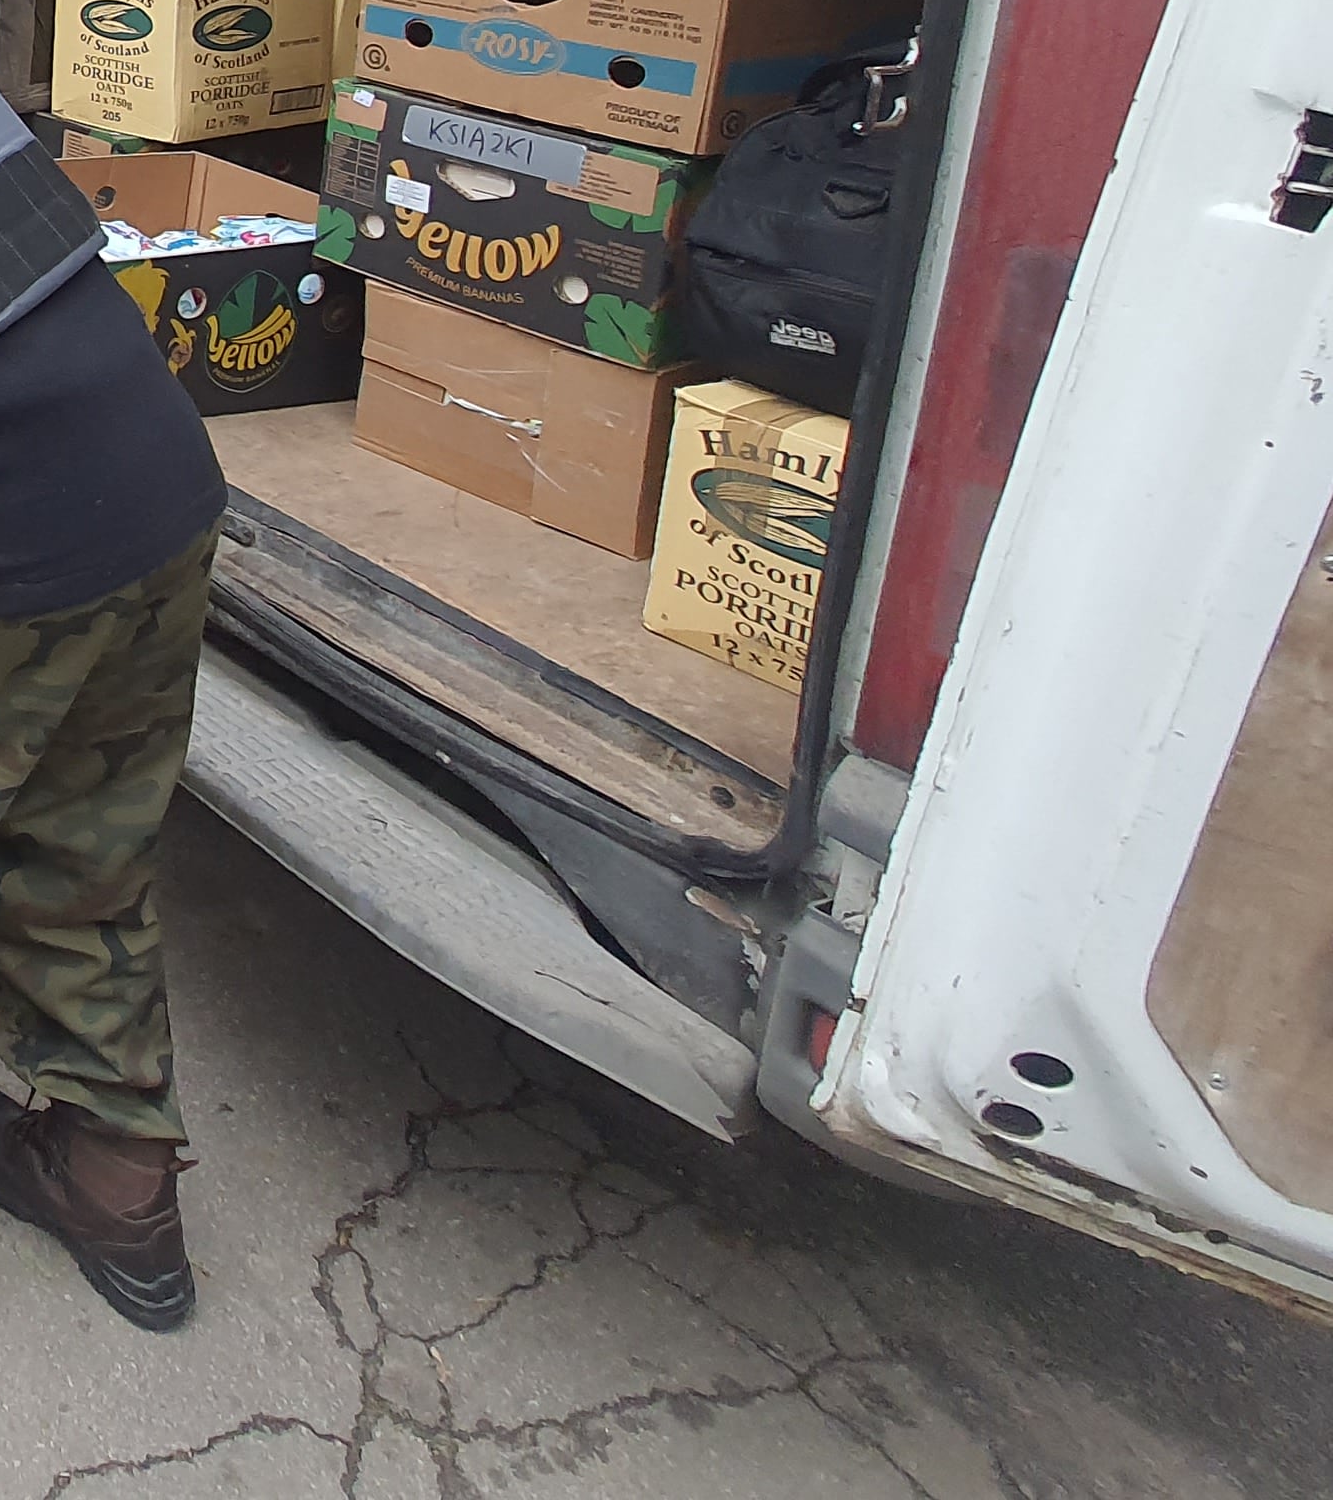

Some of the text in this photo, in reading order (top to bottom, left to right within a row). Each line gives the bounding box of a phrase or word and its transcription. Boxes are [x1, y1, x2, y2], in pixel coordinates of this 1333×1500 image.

[80, 34, 149, 57] of Scotland
[194, 43, 270, 69] of Scotland
[84, 54, 140, 73] SCOTTISH
[72, 62, 154, 90] PORRIDGE
[205, 71, 260, 86] SCOTTISH
[96, 81, 126, 95] OATS
[190, 81, 271, 103] PORRIDGE
[90, 92, 101, 103] 12
[111, 96, 133, 110] 750g
[216, 101, 244, 111] OATS
[102, 109, 121, 122] 205
[205, 119, 218, 129] 12
[605, 102, 682, 124] PRODUCT OF
[608, 112, 680, 134] GUATEMALA
[405, 256, 524, 305] PREMIUM BANANAS
[771, 319, 836, 348] Jeep
[689, 517, 727, 547] of
[712, 632, 739, 656] 12
[749, 652, 764, 667] x
